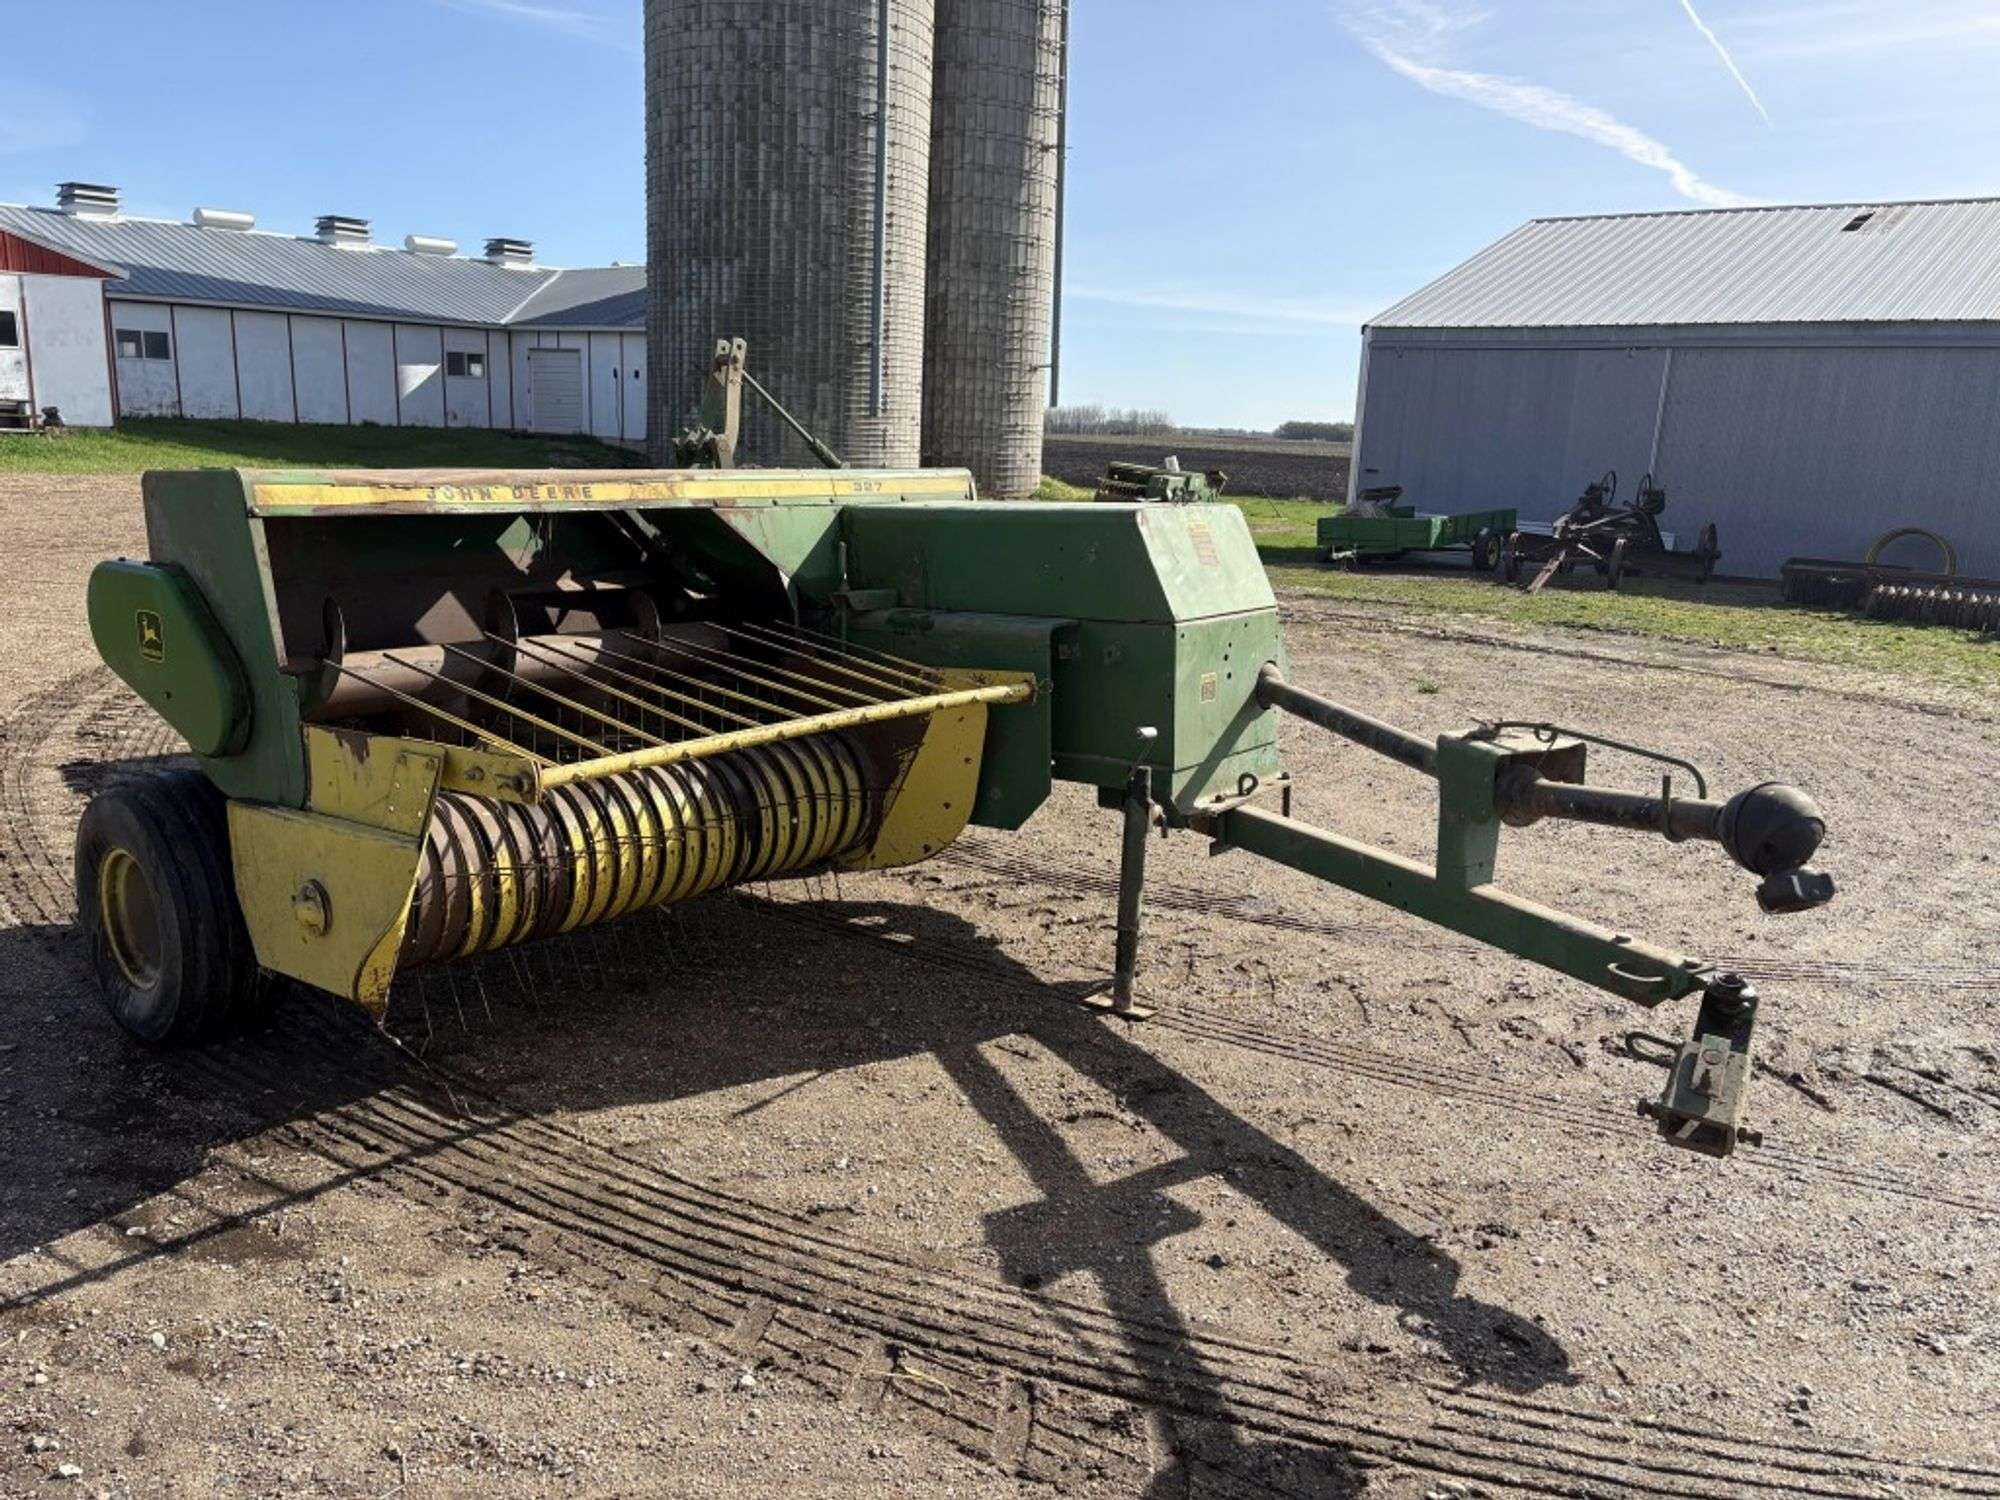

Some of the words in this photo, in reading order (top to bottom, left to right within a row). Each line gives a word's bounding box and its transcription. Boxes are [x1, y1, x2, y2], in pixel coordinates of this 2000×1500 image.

[427, 485, 491, 500] JOHN
[512, 485, 593, 499] DEERE
[853, 481, 882, 492] 327
